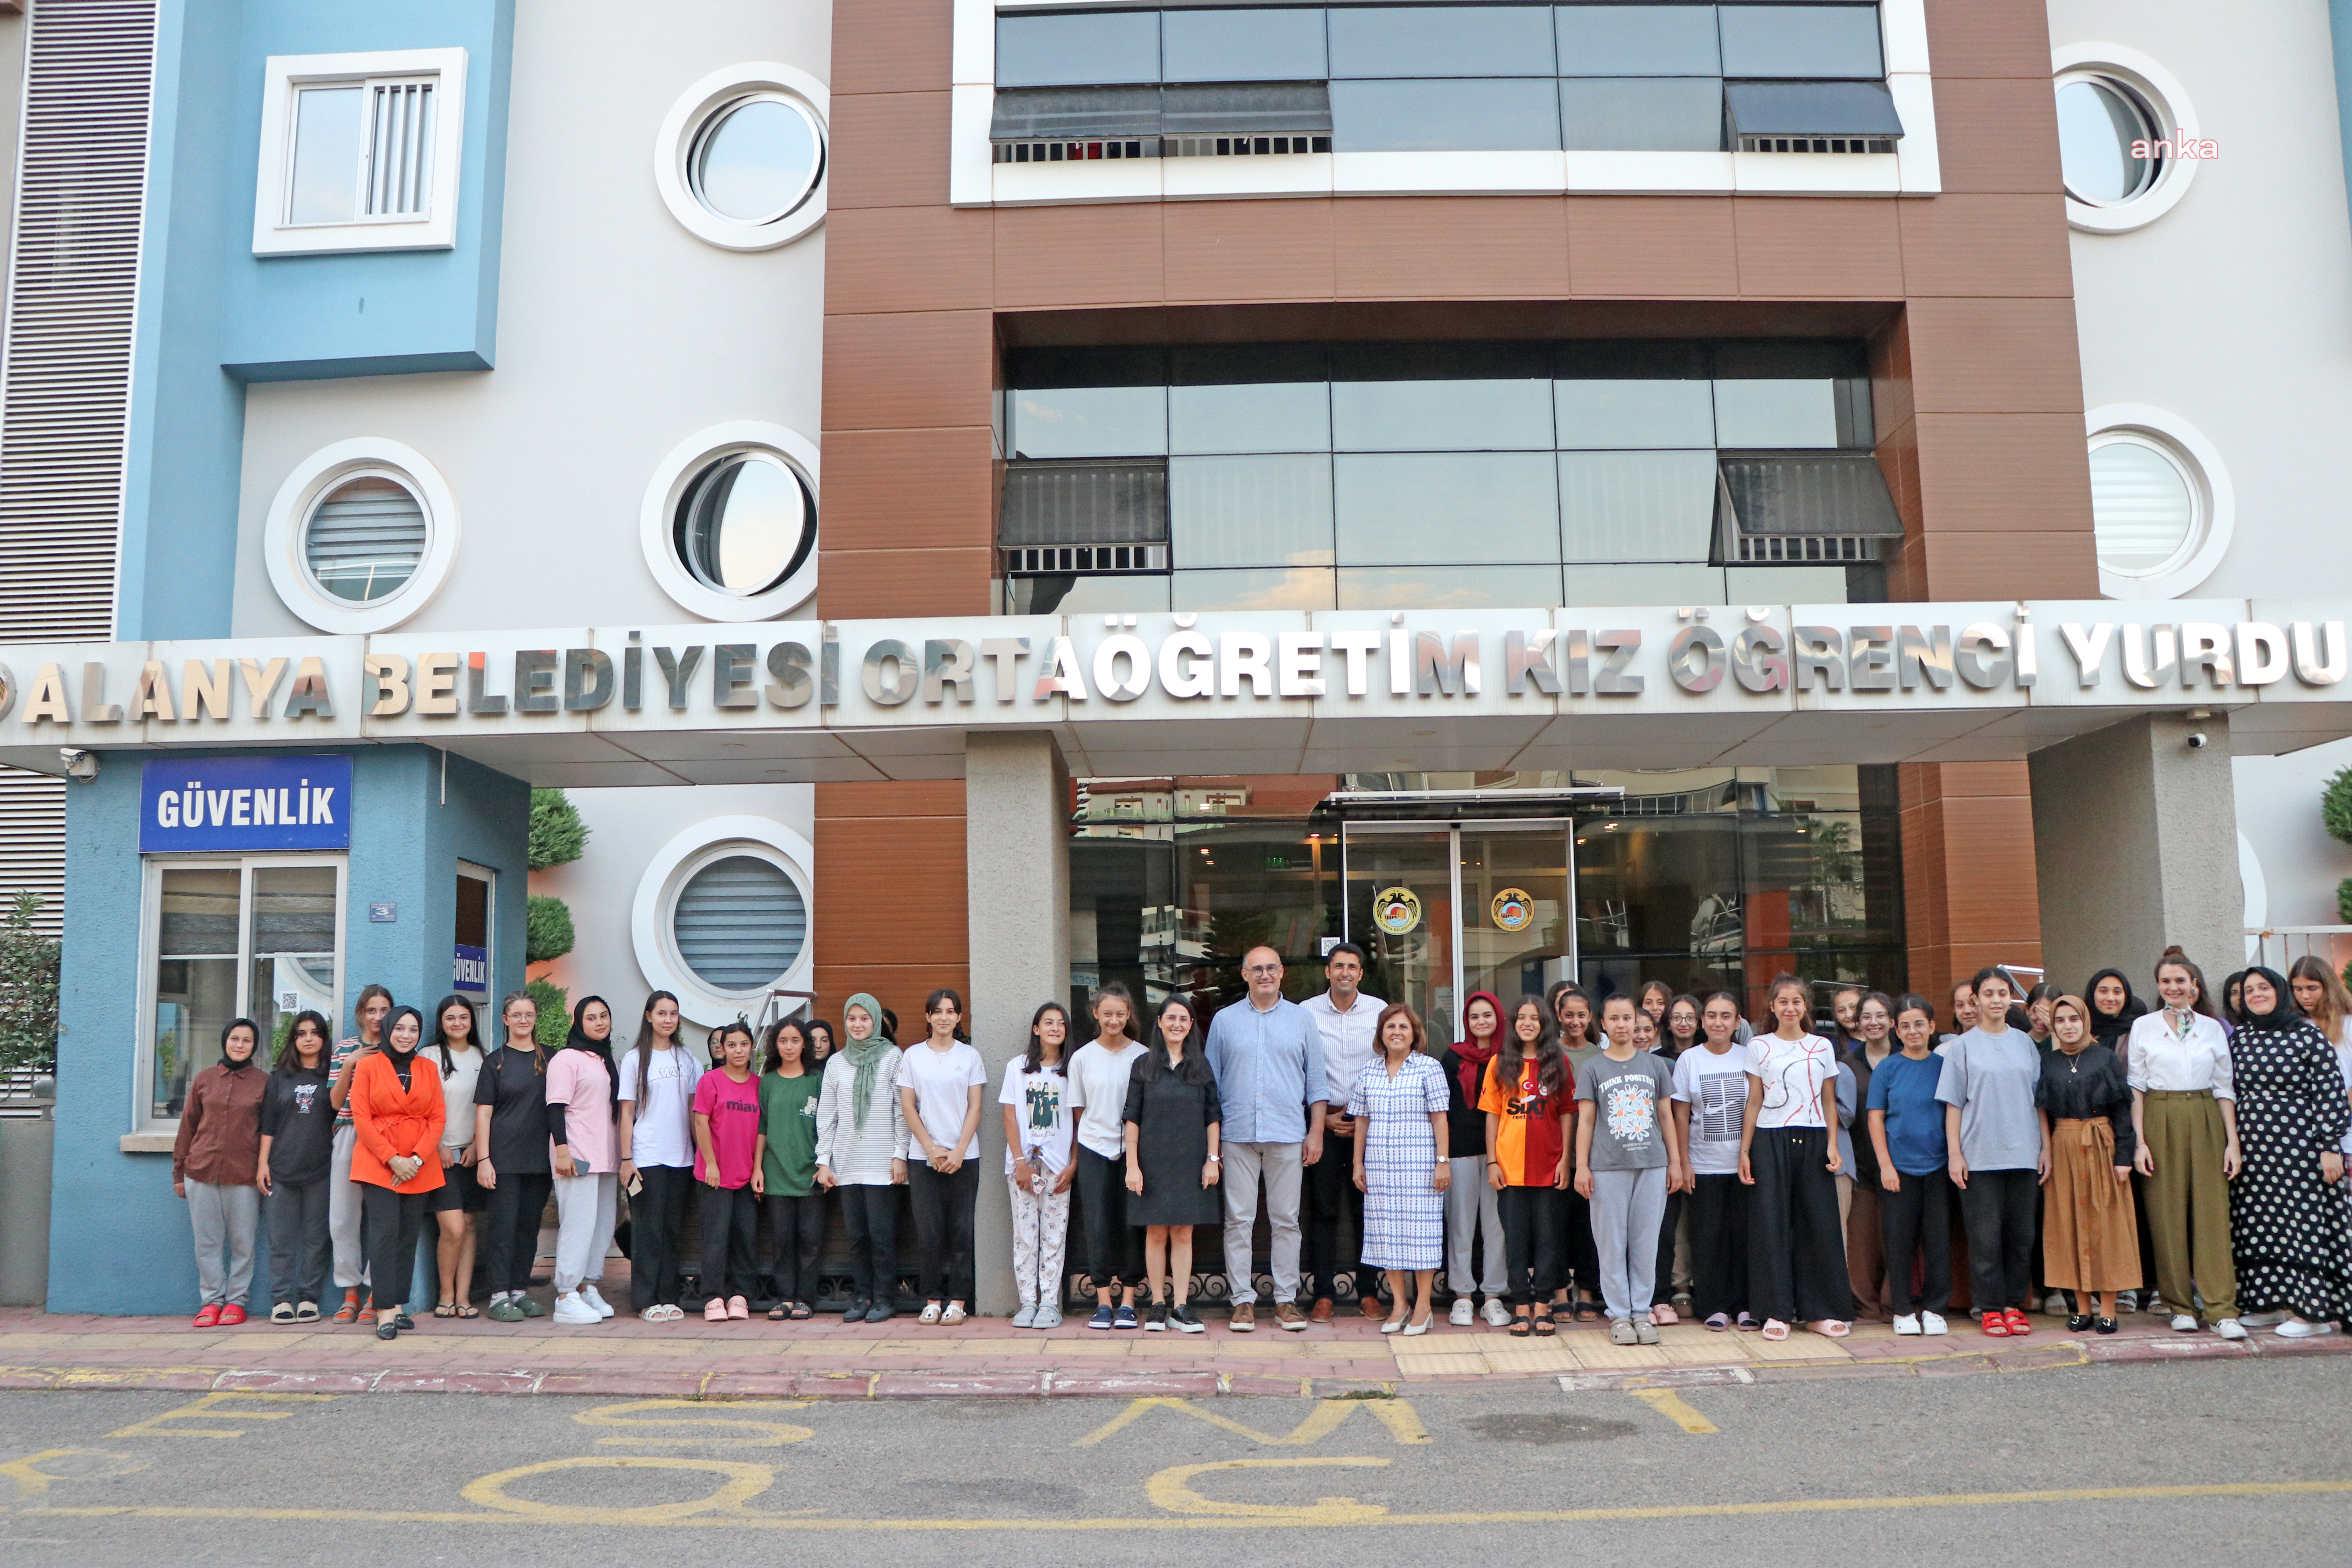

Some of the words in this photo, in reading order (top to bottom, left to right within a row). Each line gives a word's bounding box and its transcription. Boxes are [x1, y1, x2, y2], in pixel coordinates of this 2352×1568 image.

[21, 656, 334, 724] ALANYA
[365, 625, 840, 715] BELEDİYESİ
[862, 612, 1481, 705] ORTAÖĞRETİM
[1506, 629, 1645, 694] KIZ
[1668, 605, 2037, 692] ÖĞRENCİ
[2058, 621, 2348, 688] YURDU
[158, 779, 335, 828] GÜVENLİK
[1379, 920, 1393, 931] ALANYA
[1394, 919, 1415, 931] BELEDİYESİ
[1496, 918, 1509, 929] ALANYA
[1510, 918, 1530, 929] BELEDİYESİ
[1599, 1076, 1622, 1093] THINK
[727, 1100, 759, 1112] miav
